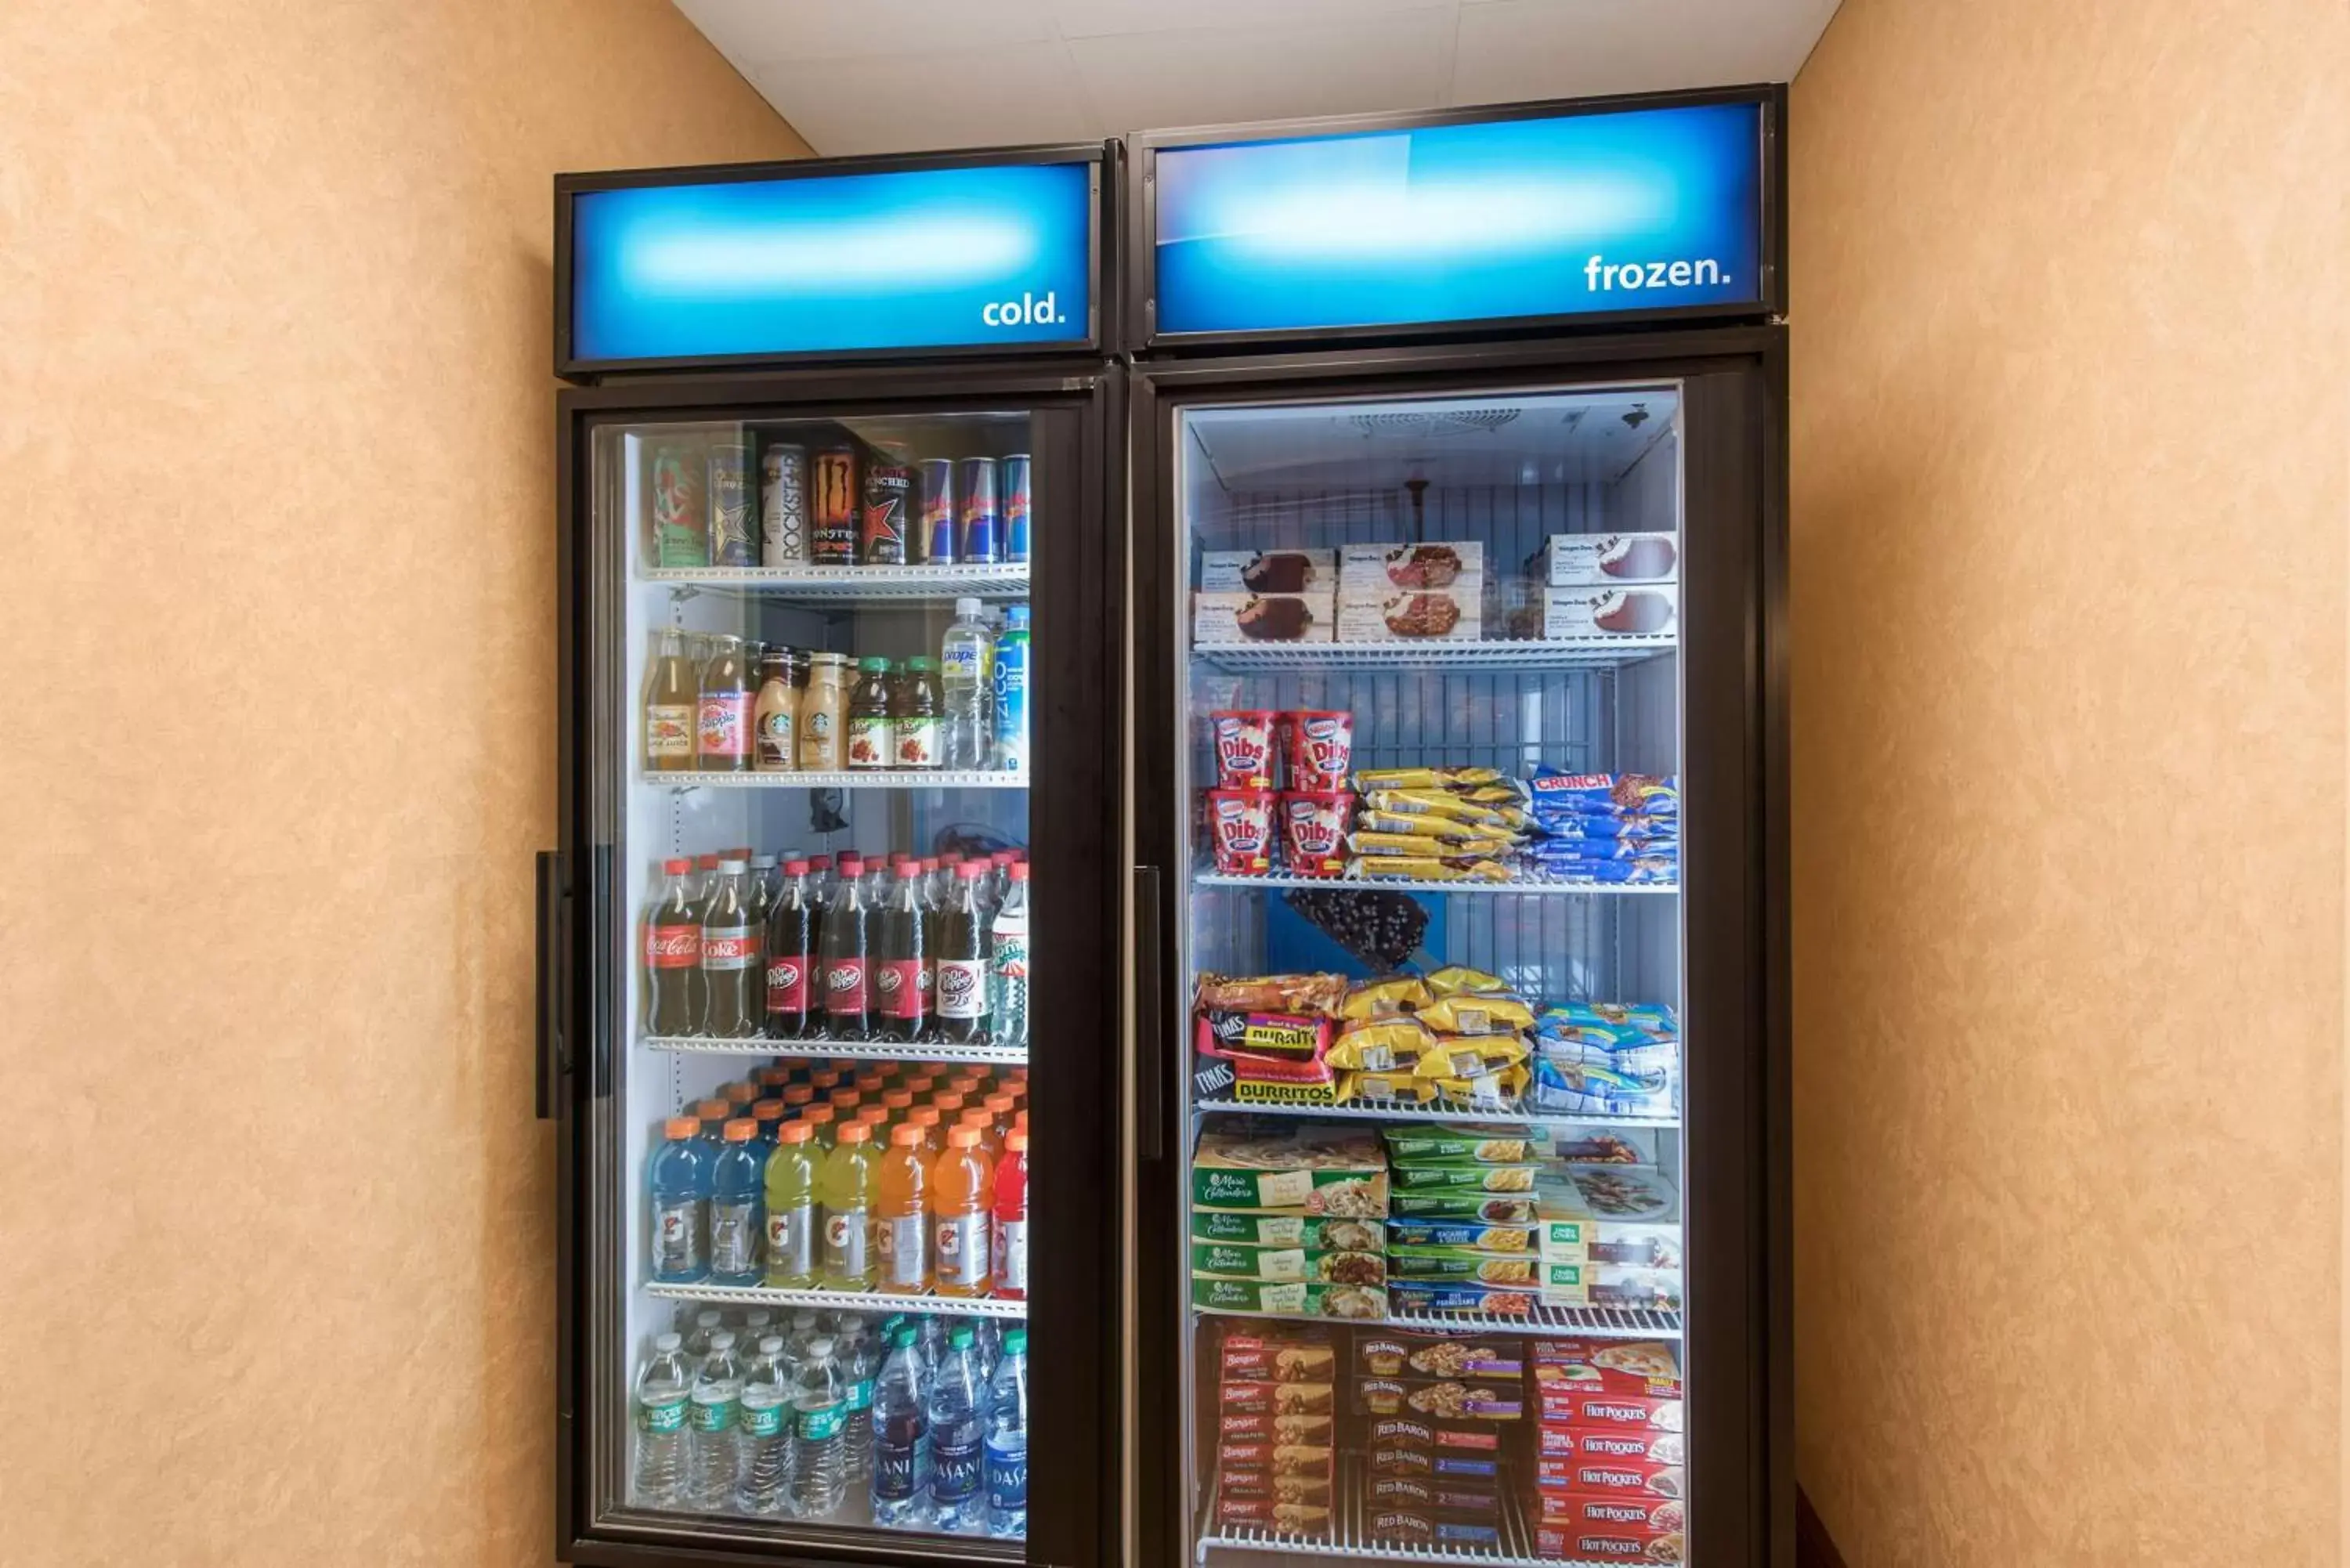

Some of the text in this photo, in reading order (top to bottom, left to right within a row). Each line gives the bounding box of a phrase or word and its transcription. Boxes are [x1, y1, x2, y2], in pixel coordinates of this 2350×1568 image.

[1583, 255, 1731, 292] frozen.
[982, 291, 1066, 327] cold.
[783, 452, 801, 561] ROCKSTAR
[813, 528, 859, 540] ONSTER
[996, 662, 1011, 718] ZICO
[1222, 737, 1264, 760] Dibs
[1535, 773, 1610, 790] CRUNCH
[1224, 818, 1267, 841] Dibs
[1295, 819, 1339, 843] Dibs
[646, 934, 699, 956] Coca-Cola
[701, 940, 739, 957] Coke
[1253, 1029, 1317, 1046] BURRIT
[1240, 1084, 1333, 1100] BURRITOS
[1365, 1341, 1405, 1356] RED BARON
[1467, 1360, 1474, 1370] 2
[1364, 1381, 1404, 1394] RED BARON
[1466, 1401, 1473, 1411] 2
[1586, 1404, 1646, 1420] HOT POCKETS
[1378, 1422, 1430, 1440] RED BARON
[1440, 1434, 1447, 1444] 2
[1585, 1439, 1603, 1451] HOT
[1605, 1440, 1645, 1454] POCKETS
[1376, 1450, 1428, 1466] RED BARON
[1439, 1461, 1446, 1470] 2
[992, 1467, 1027, 1487] DASA
[1582, 1470, 1643, 1485] HOT POCKETS
[1376, 1481, 1428, 1499] RED BARON
[1439, 1494, 1446, 1504] 2
[1587, 1506, 1646, 1520] HOT POCKETS
[1377, 1516, 1429, 1532] RED BARON
[1440, 1527, 1447, 1537] 2
[1582, 1539, 1641, 1552] HOT POCKETS
